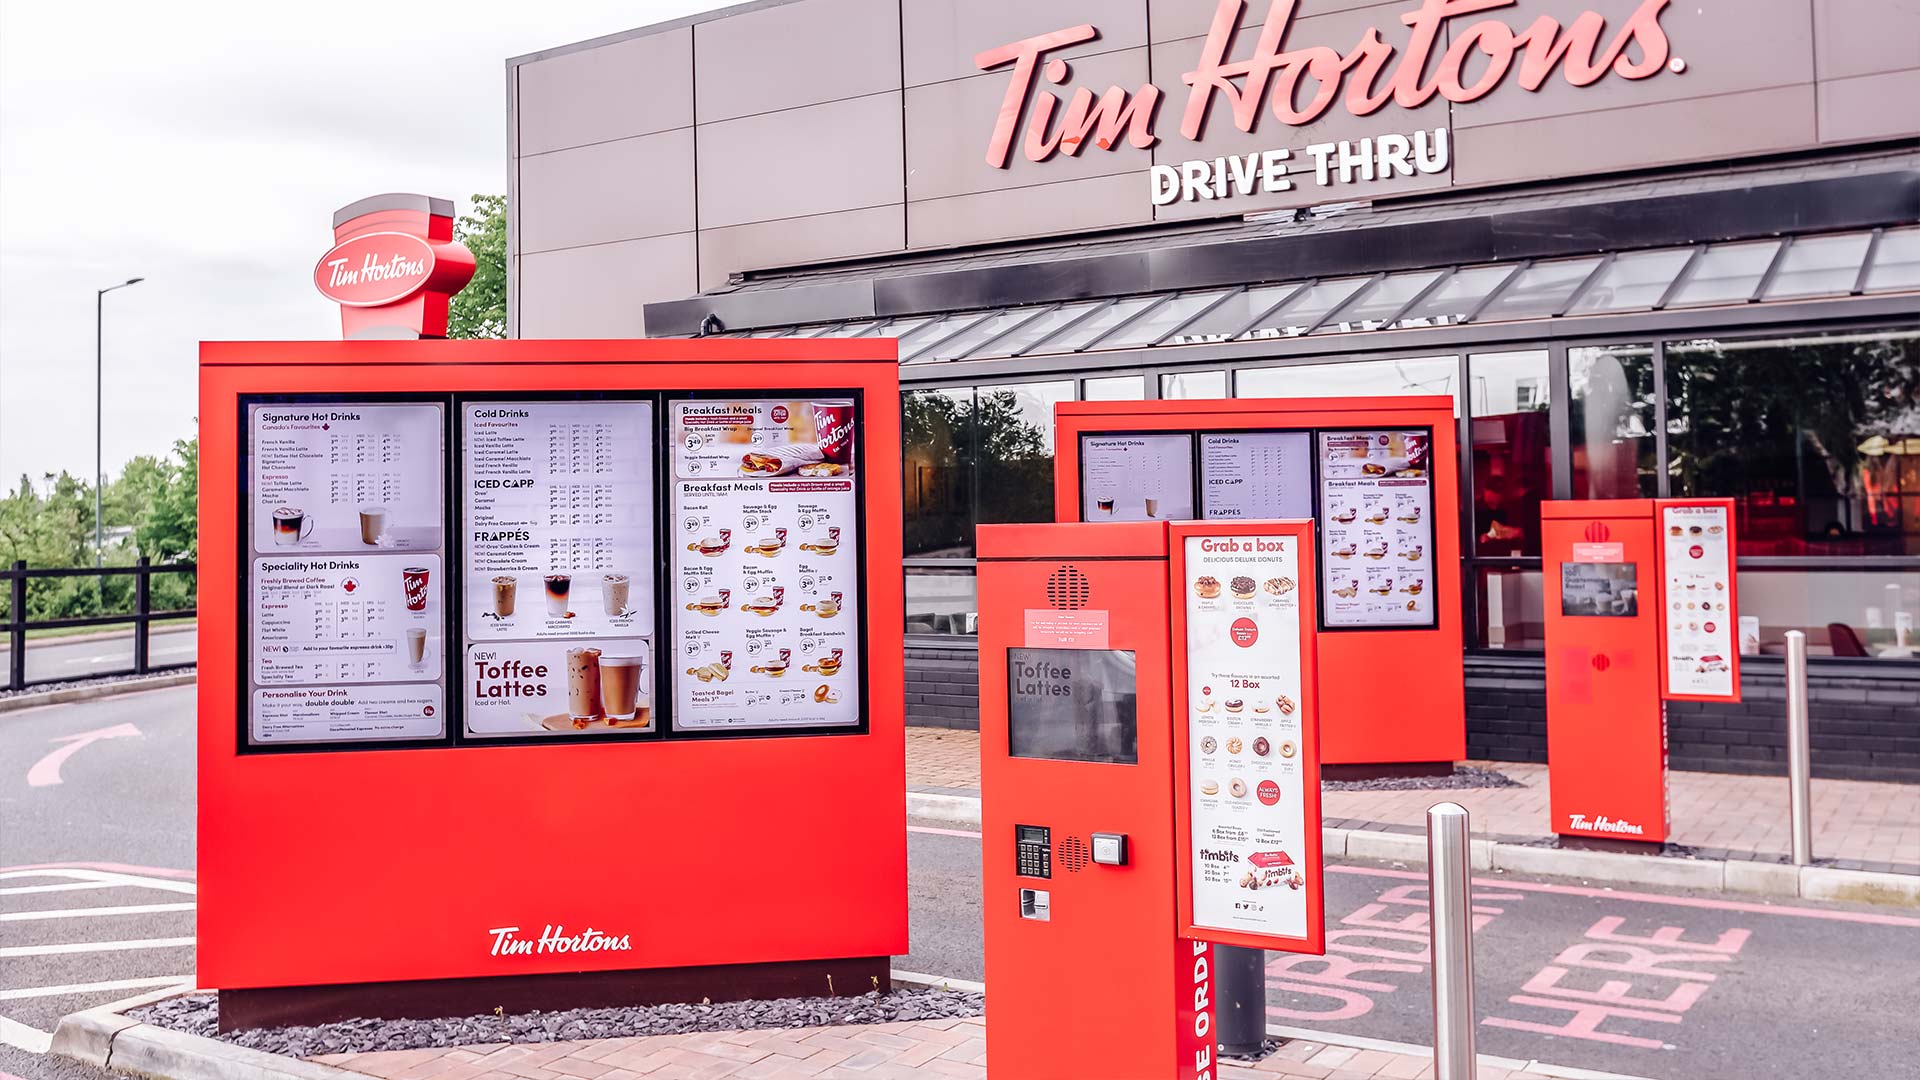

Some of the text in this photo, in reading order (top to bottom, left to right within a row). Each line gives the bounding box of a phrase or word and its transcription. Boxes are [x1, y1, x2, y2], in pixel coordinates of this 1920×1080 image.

[974, 0, 1671, 169] Tim Hortons
[1150, 127, 1448, 205] DRIVE THRU
[328, 253, 425, 288] Tim Hortons
[499, 409, 529, 417] Drinks
[683, 406, 762, 414] Breakfast Meals
[262, 412, 360, 424] Signature Hot Drinks
[815, 410, 835, 431] Tim
[474, 480, 500, 488] ICED
[683, 483, 763, 492] Breakfast Meals
[475, 528, 529, 541] FRAPPÉS
[1201, 538, 1284, 552] Grab a box
[262, 561, 359, 573] Speciality Hot Drinks
[404, 576, 423, 591] Tim
[474, 652, 496, 660] NEW!
[474, 660, 548, 680] Toffee
[1015, 662, 1072, 679] Toffee
[476, 680, 547, 698] Lattes
[1016, 678, 1071, 696] Lattes
[1230, 679, 1260, 688] 12 Box
[1569, 814, 1644, 834] Tim Hortons
[1200, 849, 1239, 862] timbits
[1266, 867, 1292, 878] timbits
[488, 924, 630, 956] Tim Hortons
[1480, 916, 1752, 1050] HERE
